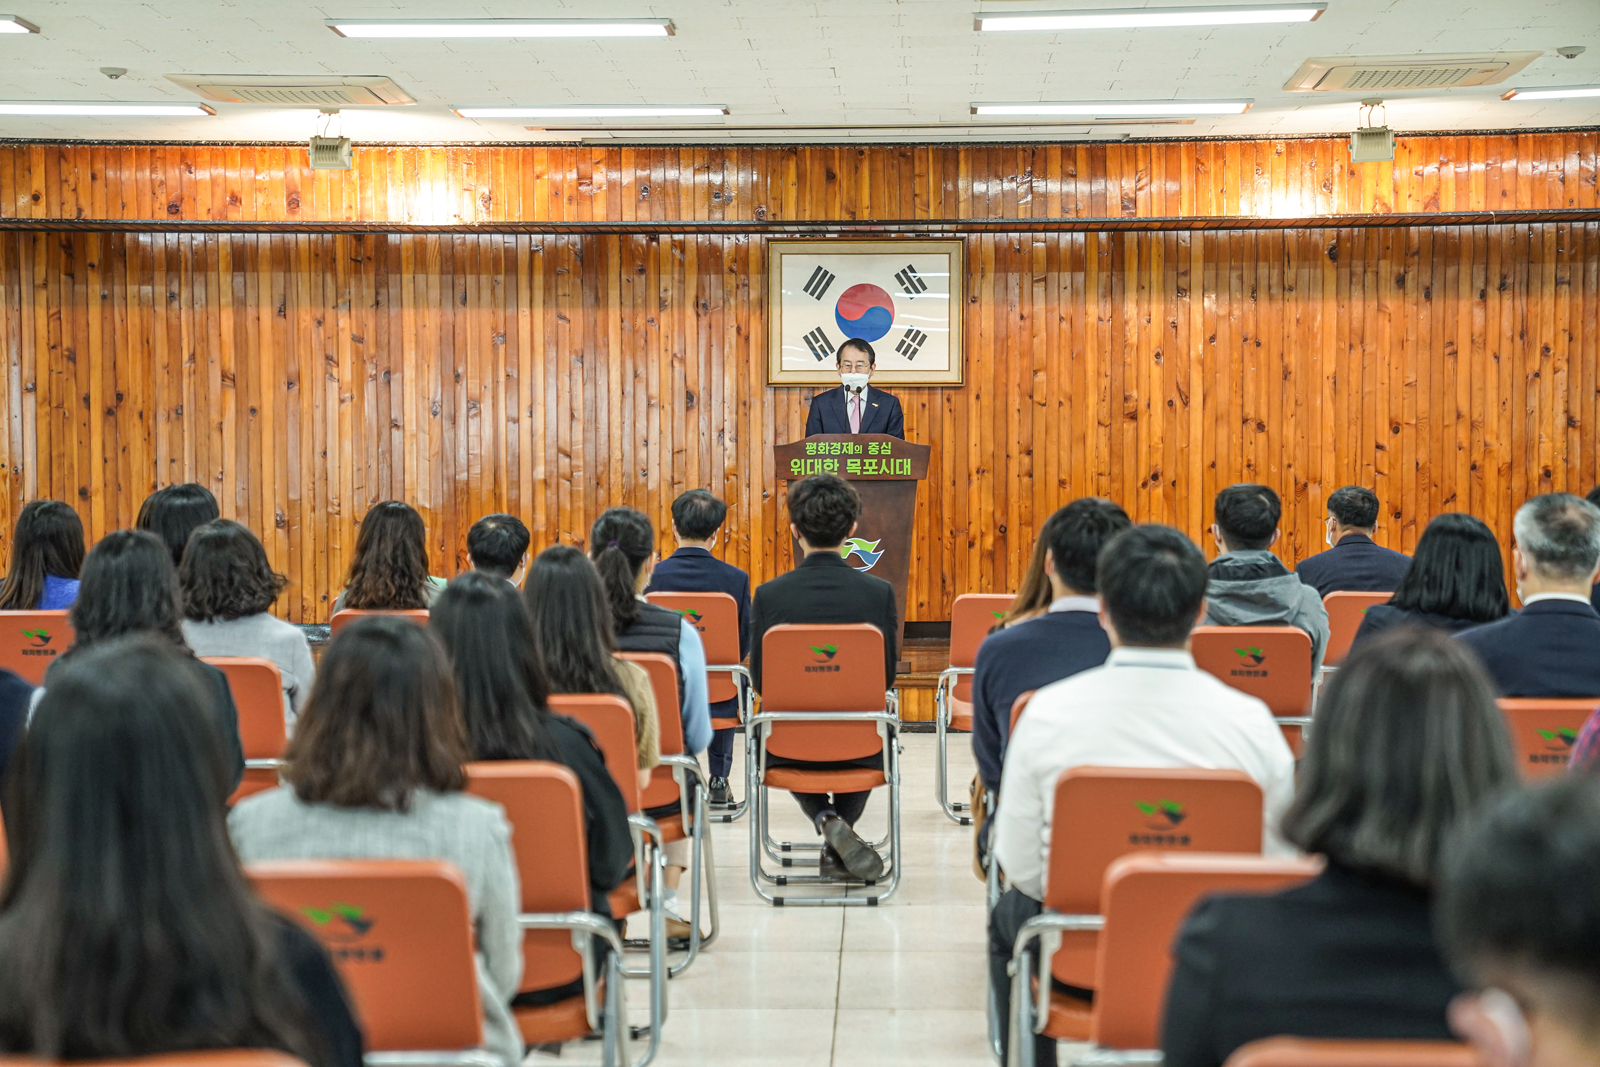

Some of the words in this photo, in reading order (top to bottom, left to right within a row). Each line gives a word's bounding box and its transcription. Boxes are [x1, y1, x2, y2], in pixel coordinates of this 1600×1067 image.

[805, 442, 863, 455] 평화경제의
[868, 441, 892, 455] 중심
[790, 458, 840, 476] 위대한
[846, 458, 912, 476] 목포시대
